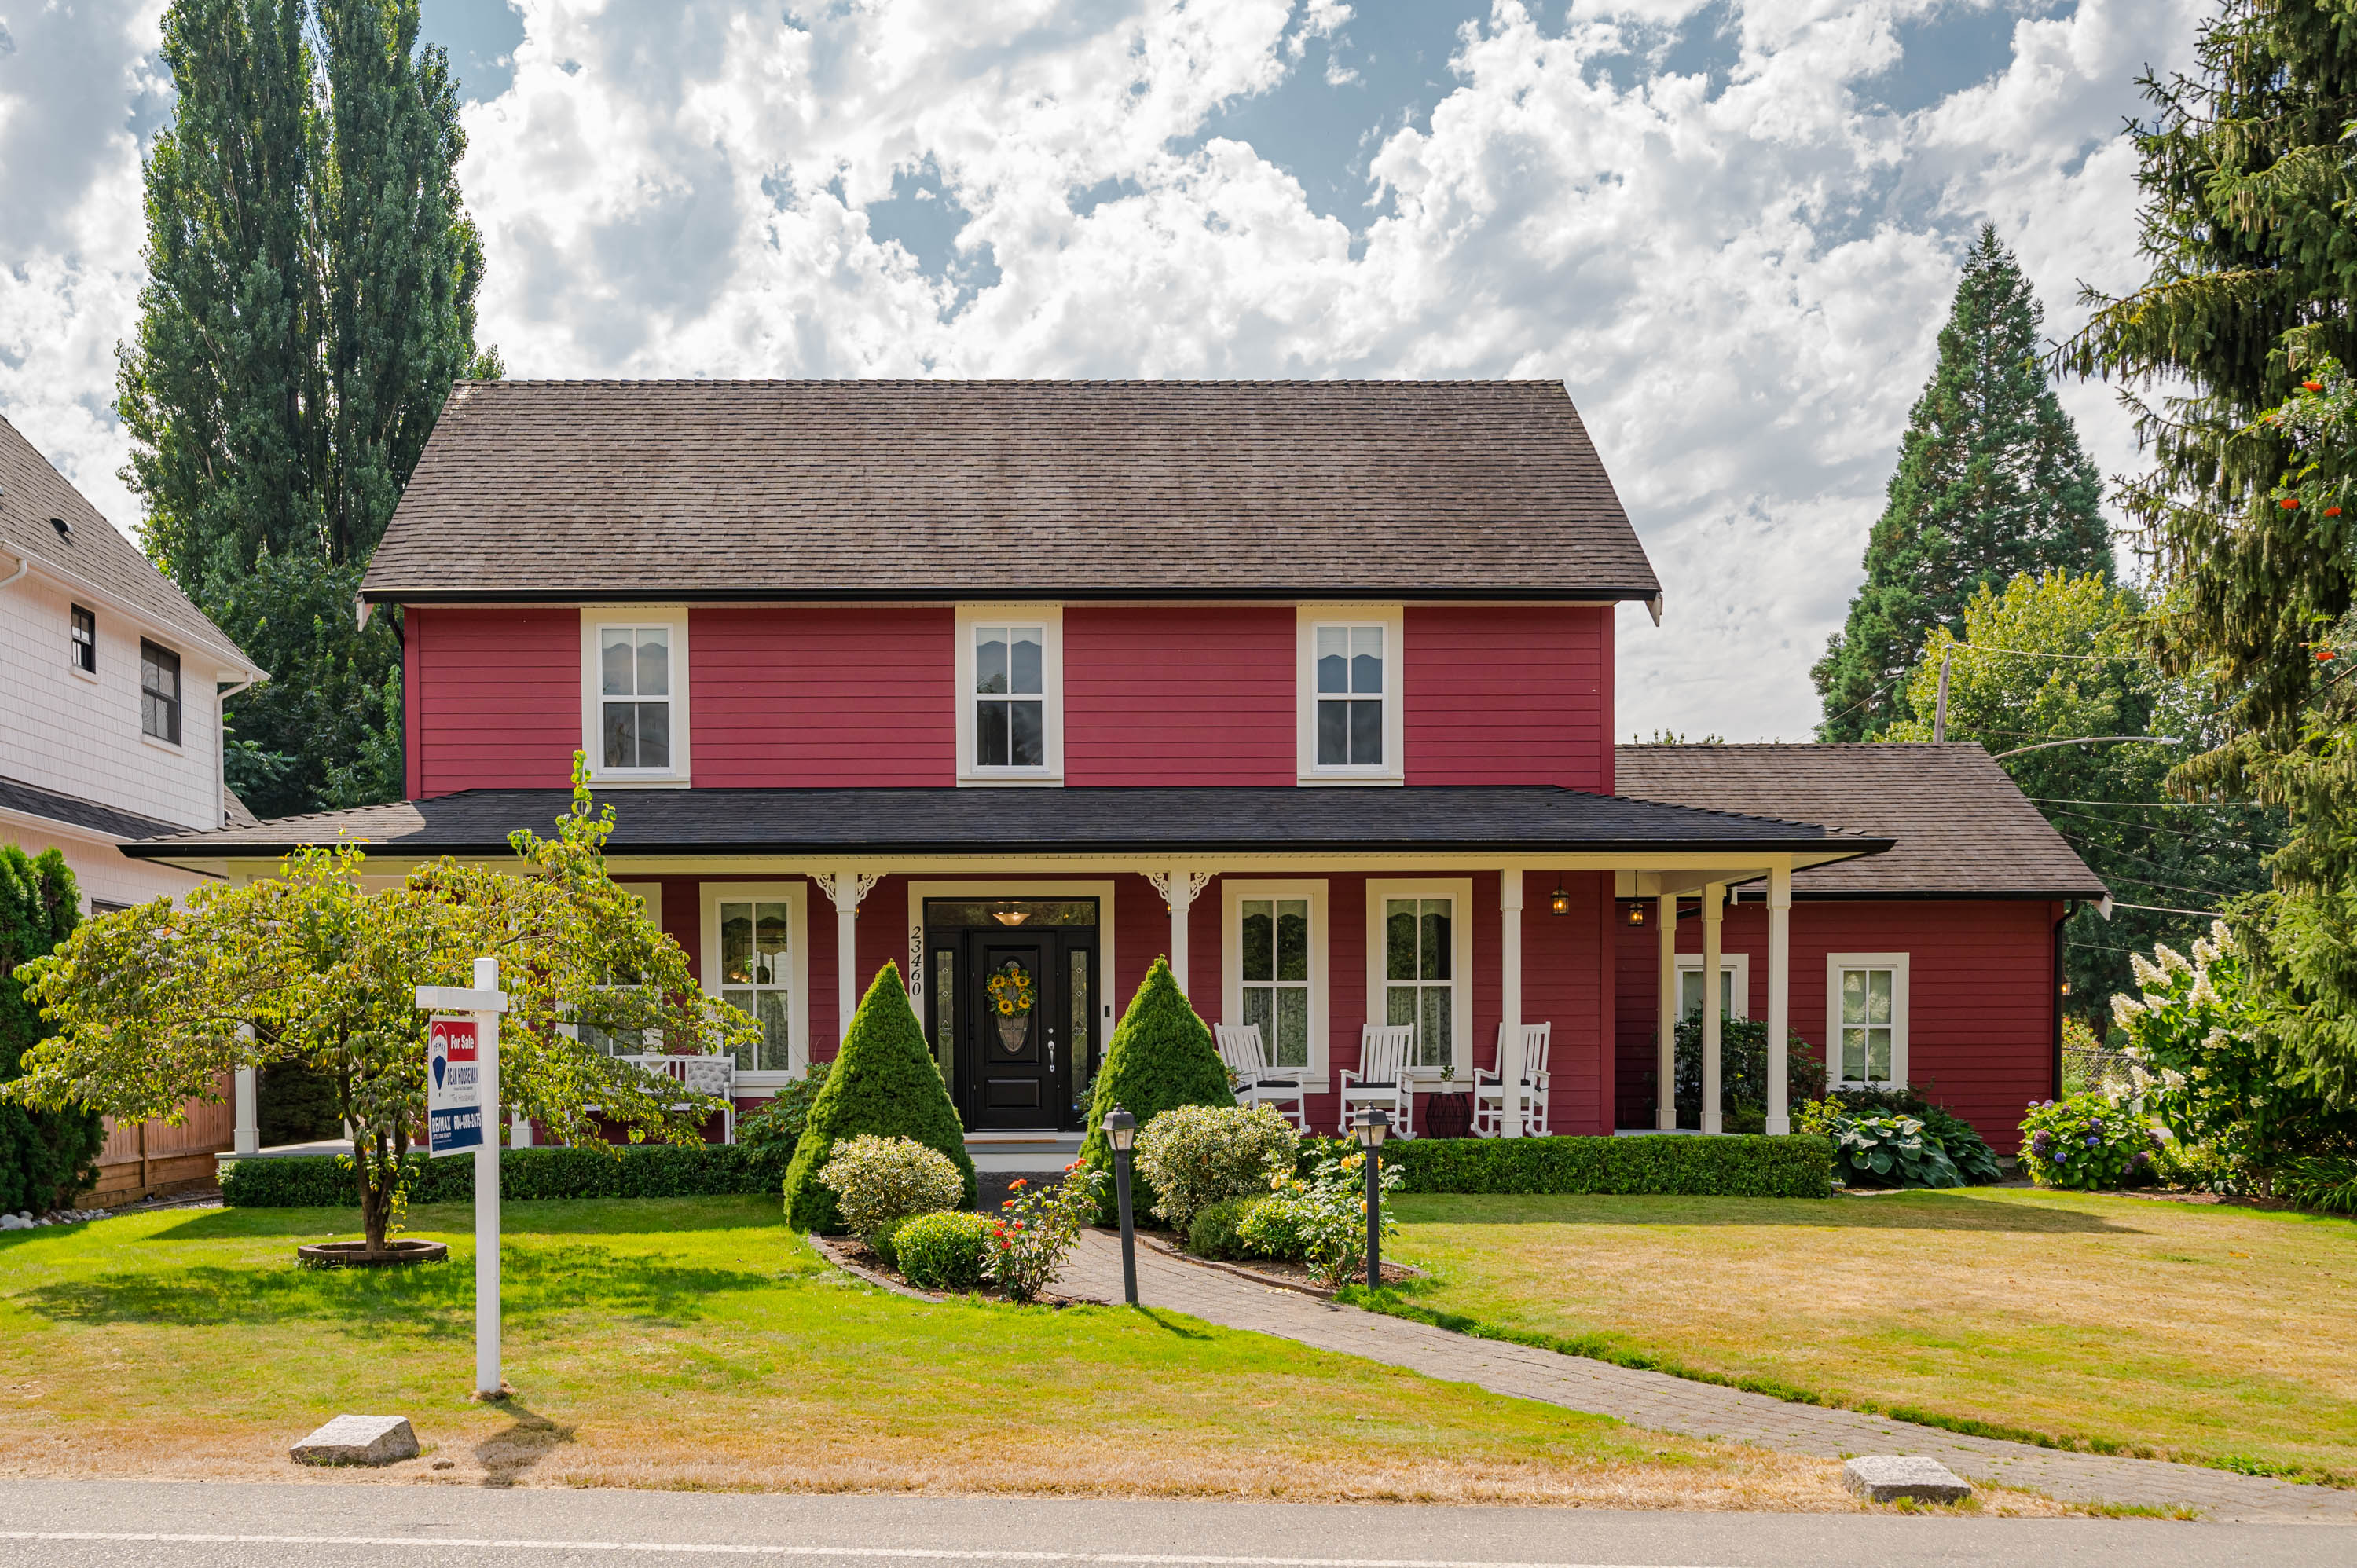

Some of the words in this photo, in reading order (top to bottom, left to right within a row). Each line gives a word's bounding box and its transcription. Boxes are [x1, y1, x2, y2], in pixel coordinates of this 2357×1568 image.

[911, 925, 922, 996] 23460
[451, 1034, 460, 1050] For
[461, 1034, 475, 1050] Sale
[447, 1068, 457, 1085] DEAN
[432, 1116, 451, 1133] RE/MAX
